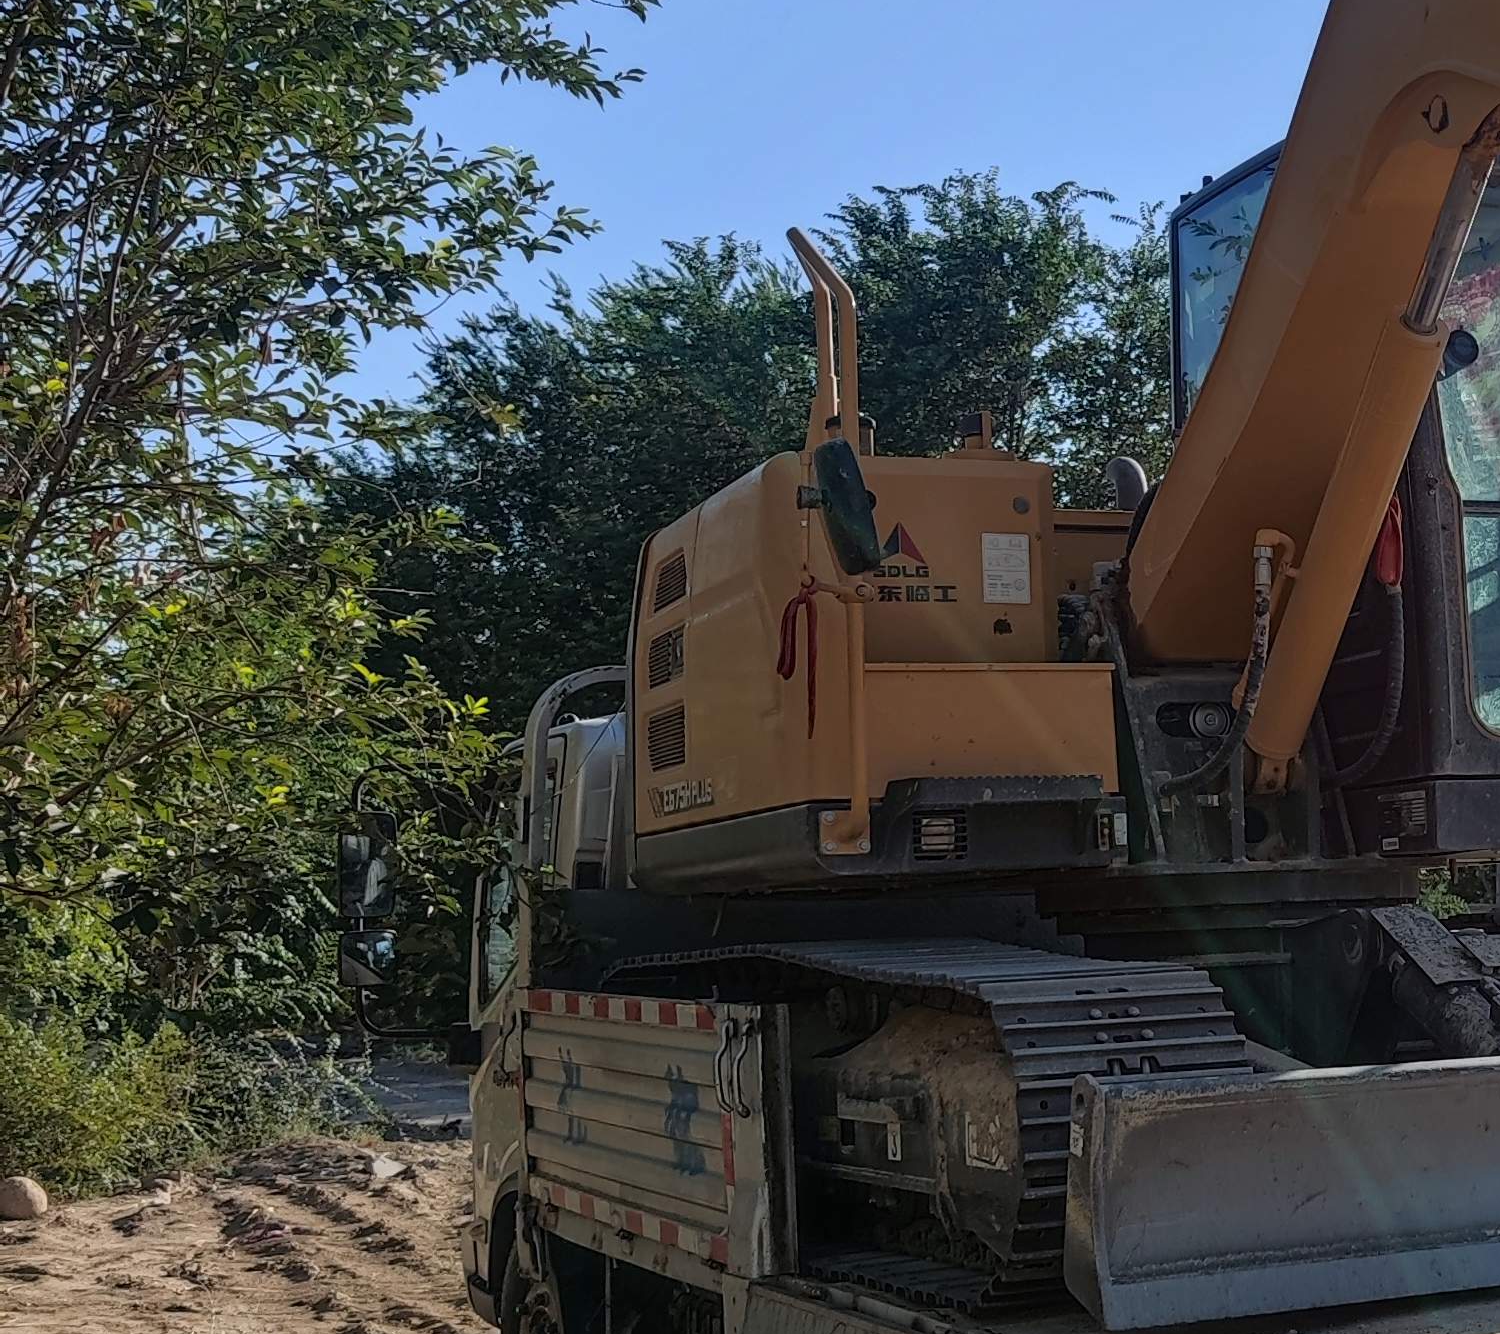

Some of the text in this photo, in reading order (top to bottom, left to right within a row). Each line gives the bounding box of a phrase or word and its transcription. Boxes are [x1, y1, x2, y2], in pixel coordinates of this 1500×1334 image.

[873, 565, 930, 578] SDLG
[870, 584, 958, 603] 东临工
